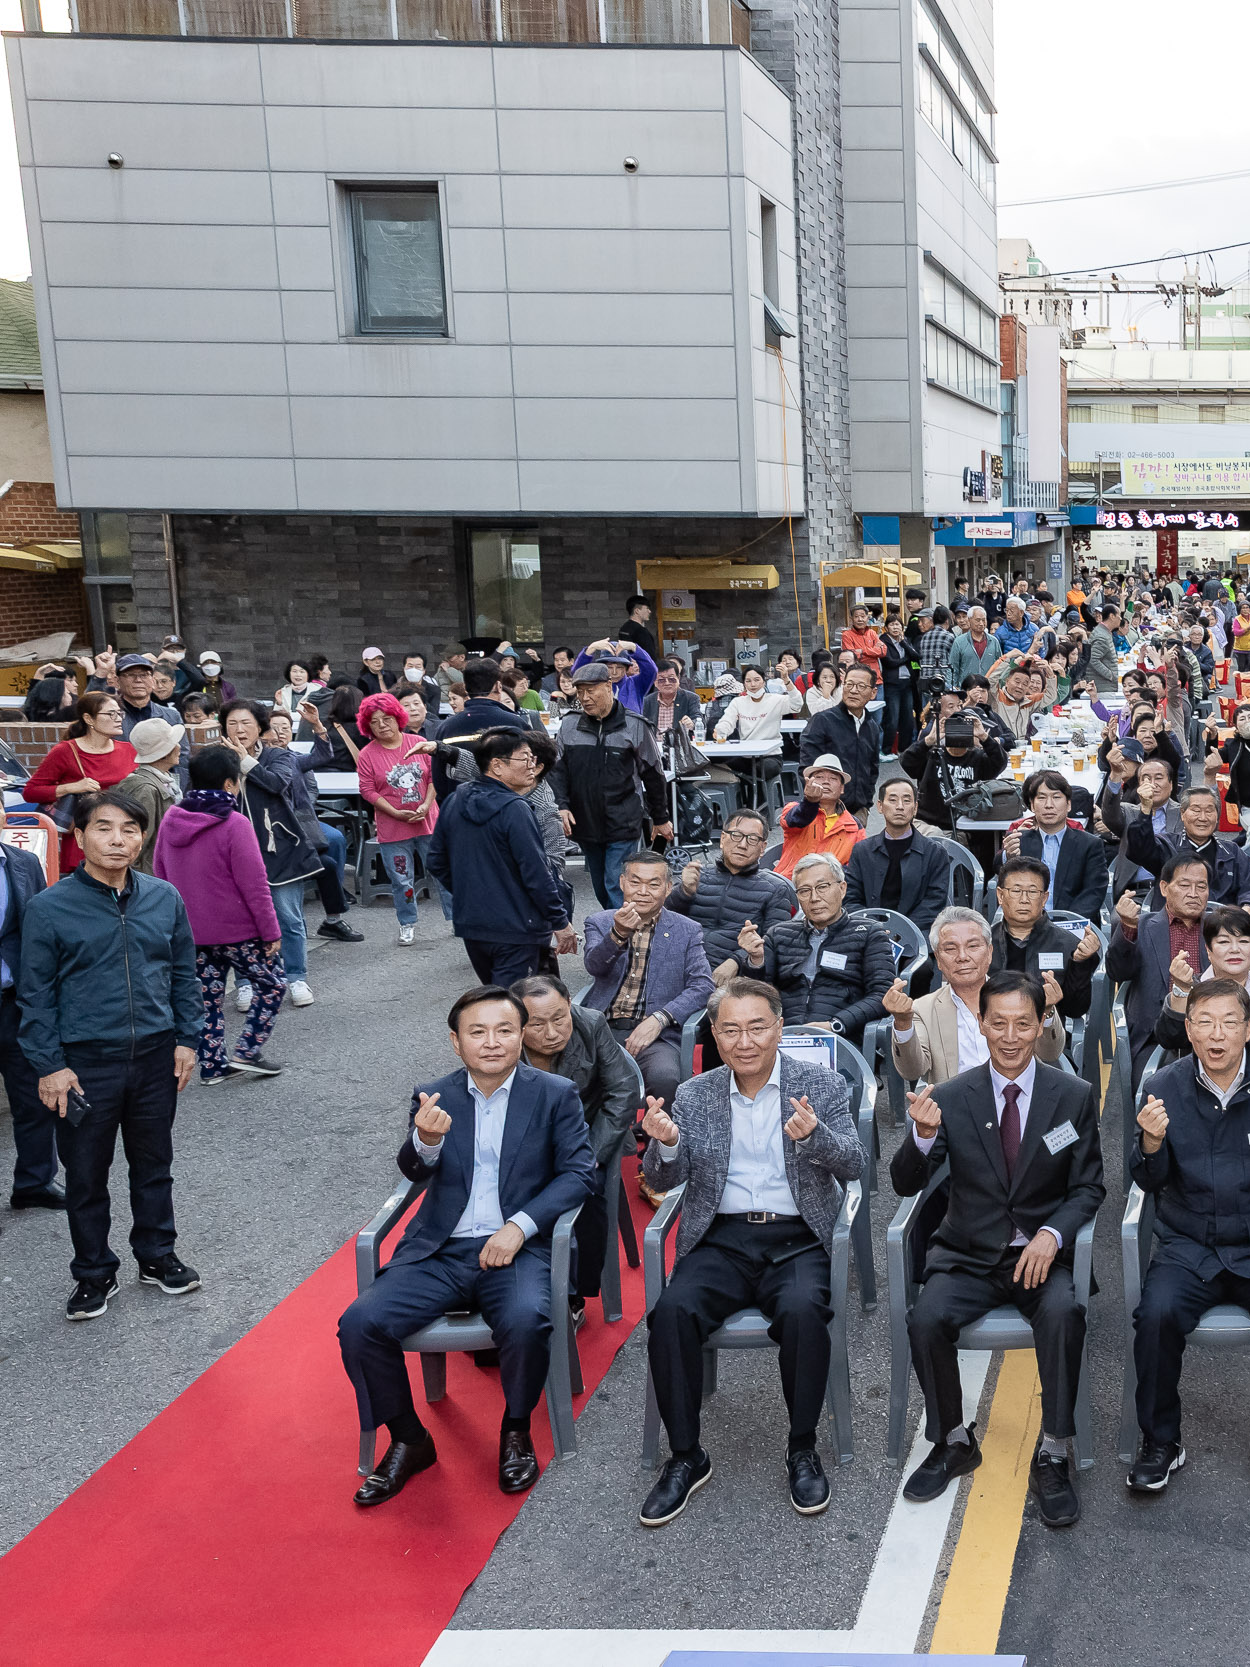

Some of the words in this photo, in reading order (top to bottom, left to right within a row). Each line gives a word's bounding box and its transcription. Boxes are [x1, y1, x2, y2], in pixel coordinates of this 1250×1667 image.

[1132, 463, 1169, 479] 잠깐!
[1173, 462, 1213, 472] 시장에서도
[1173, 473, 1212, 483] 장바구니를
[1214, 473, 1230, 483] 이용
